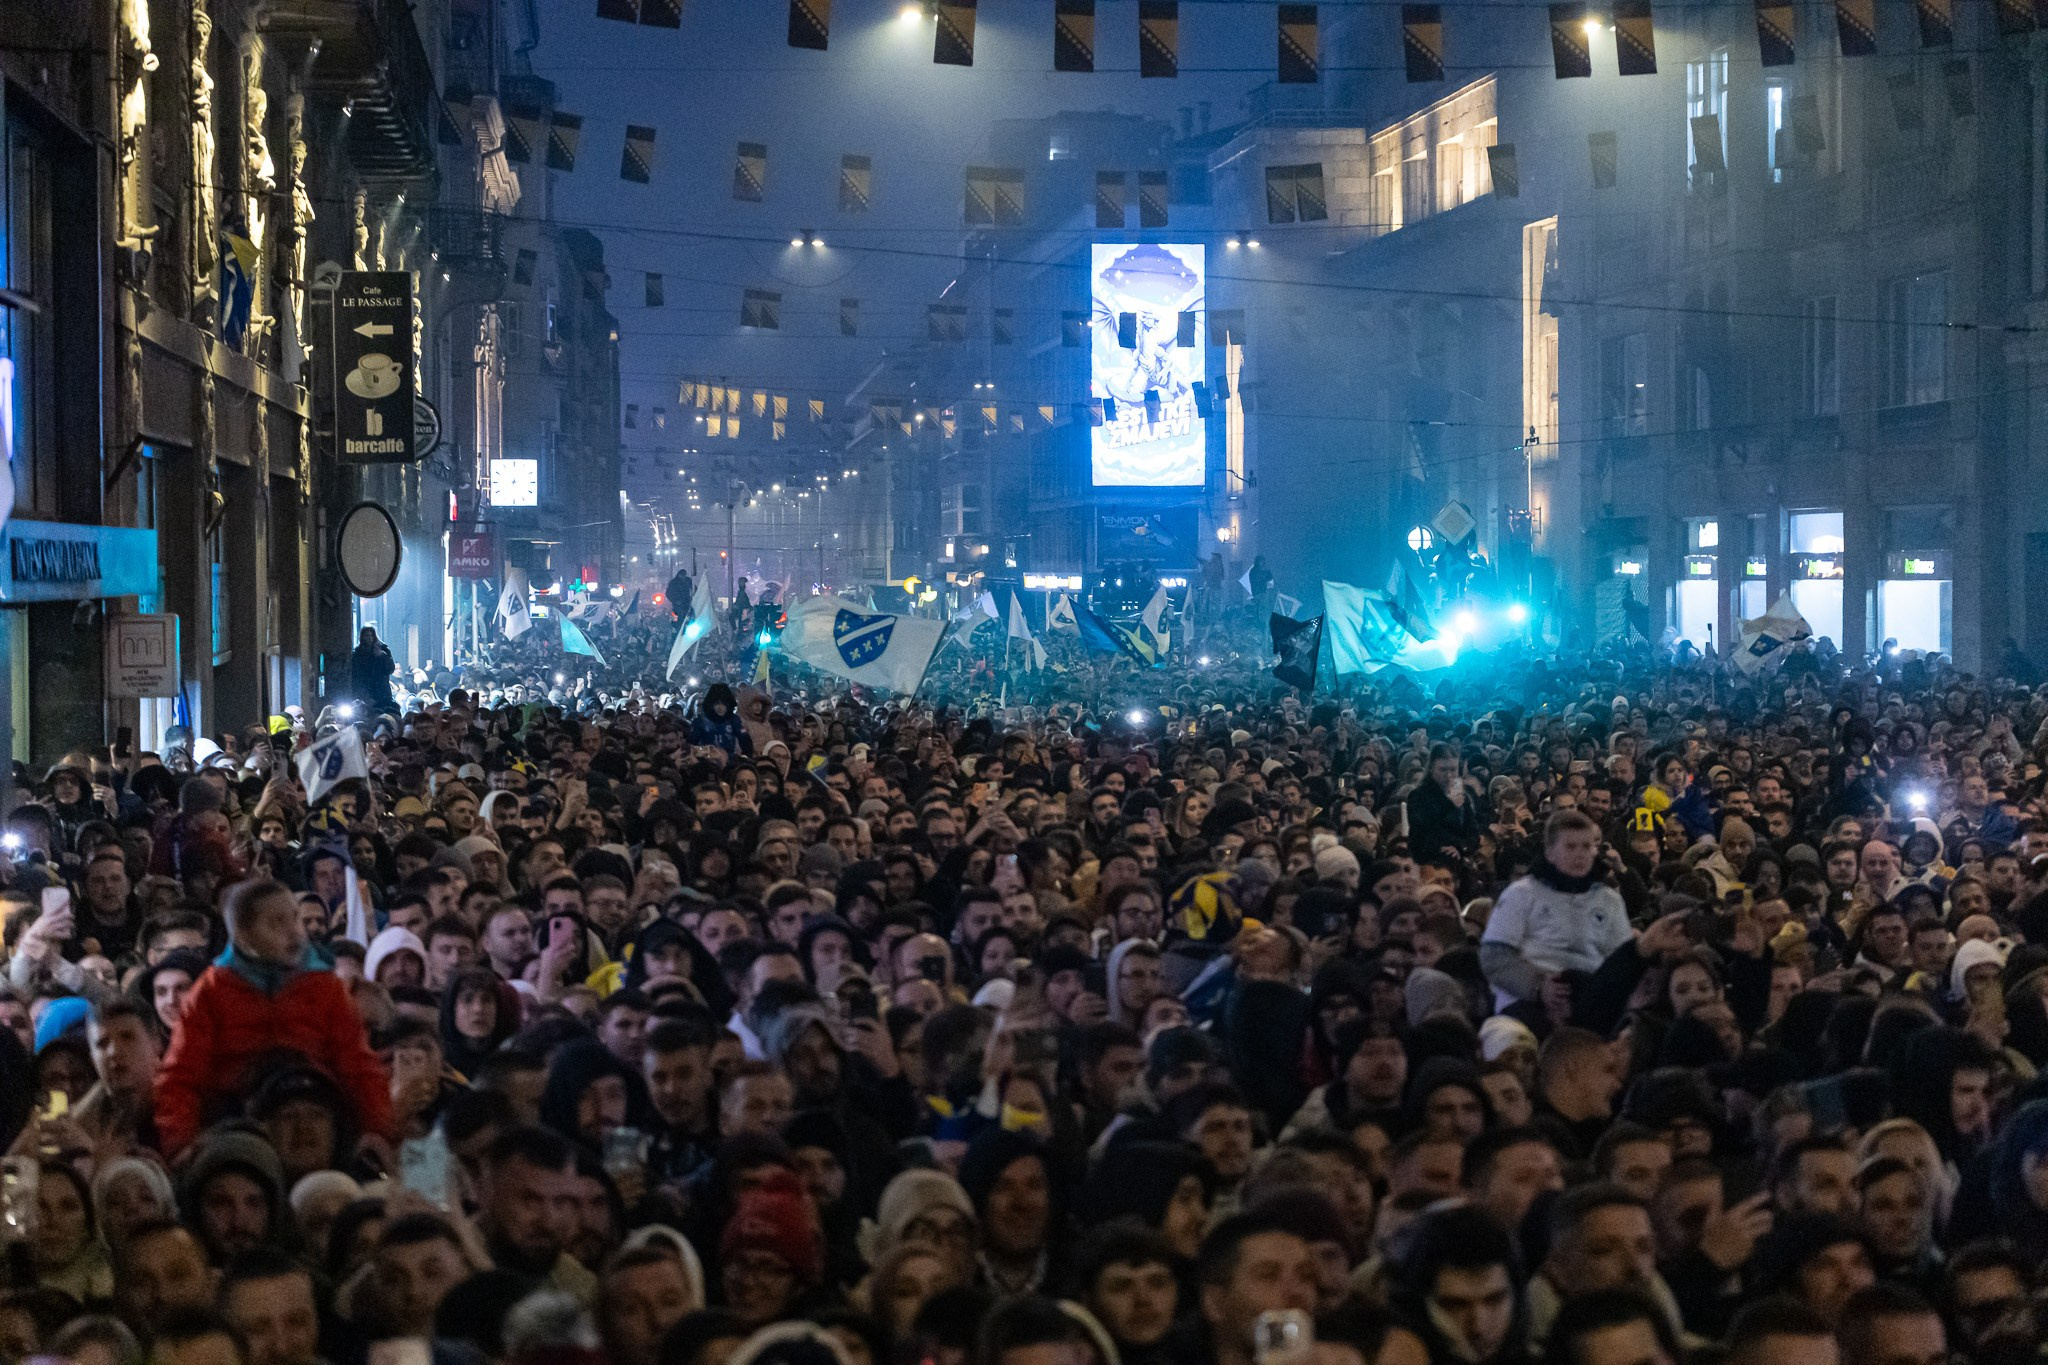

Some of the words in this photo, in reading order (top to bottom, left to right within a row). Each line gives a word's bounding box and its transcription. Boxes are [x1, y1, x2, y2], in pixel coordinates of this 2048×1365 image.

[363, 286, 381, 295] Cafe
[343, 298, 356, 307] LE
[358, 297, 402, 307] PASSAGE
[1108, 417, 1191, 449] ZMAJEVI
[452, 557, 490, 567] AMKO
